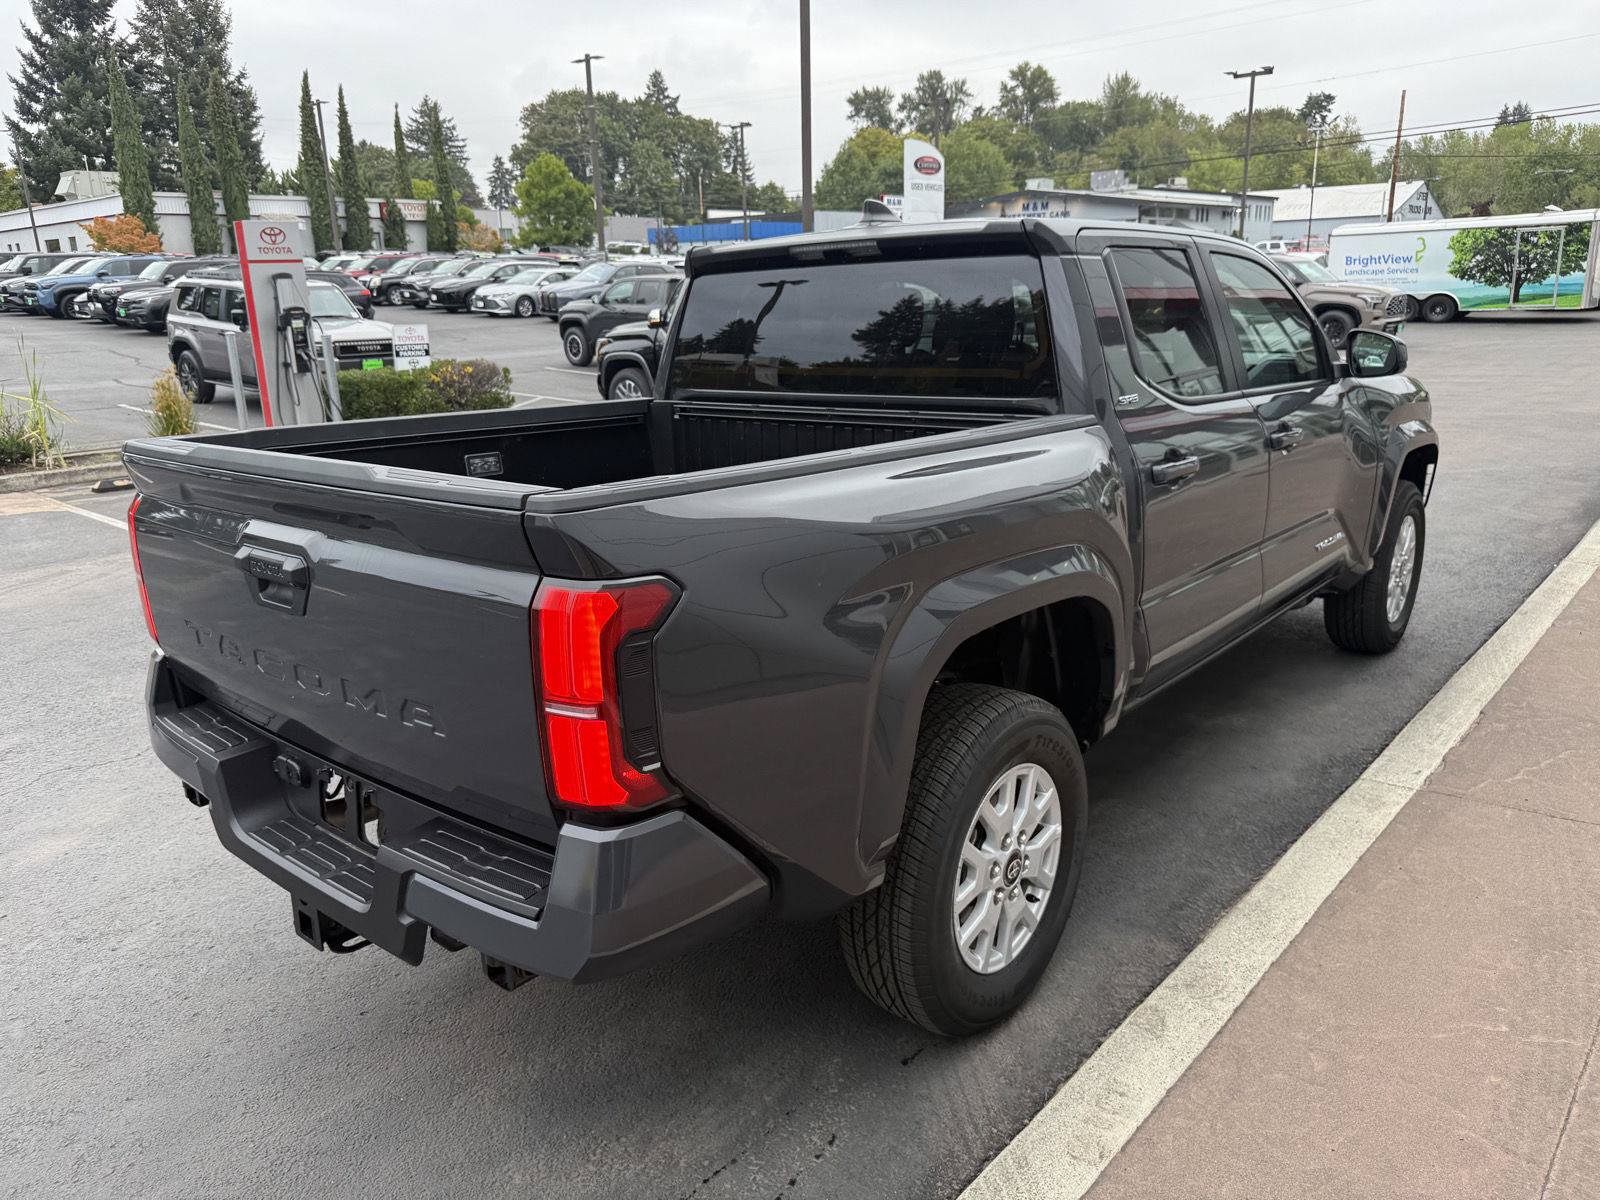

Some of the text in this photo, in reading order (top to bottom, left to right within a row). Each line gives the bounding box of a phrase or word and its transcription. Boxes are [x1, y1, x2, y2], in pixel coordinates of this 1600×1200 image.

[403, 203, 427, 212] TOYOT
[257, 246, 293, 255] TOYOTA
[1345, 254, 1413, 267] BrightView
[1344, 266, 1419, 276] Landscape Services
[184, 617, 447, 739] TACOMA
